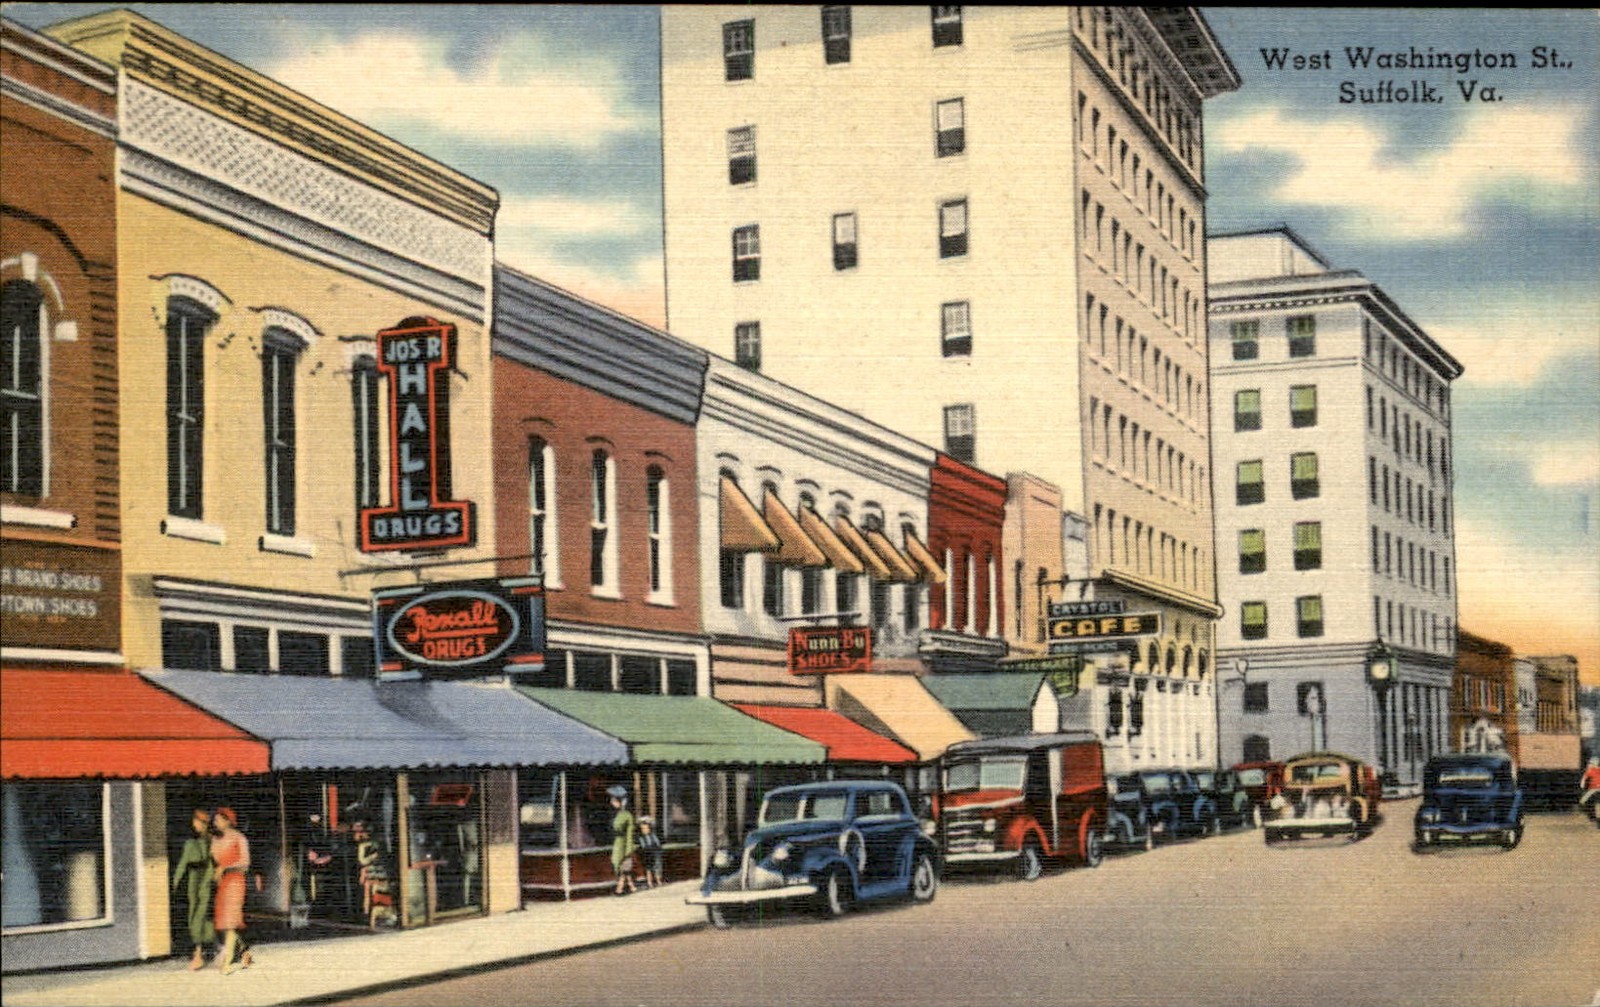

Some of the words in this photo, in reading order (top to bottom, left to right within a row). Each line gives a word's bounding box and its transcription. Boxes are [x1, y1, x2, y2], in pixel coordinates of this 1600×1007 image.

[385, 338, 421, 362] JOS
[426, 336, 441, 358] R
[400, 362, 428, 511] HALL
[373, 511, 460, 539] DRUGS
[49, 597, 98, 619] SHOES
[1054, 616, 1142, 637] CAFE
[422, 636, 487, 660] DRUGS
